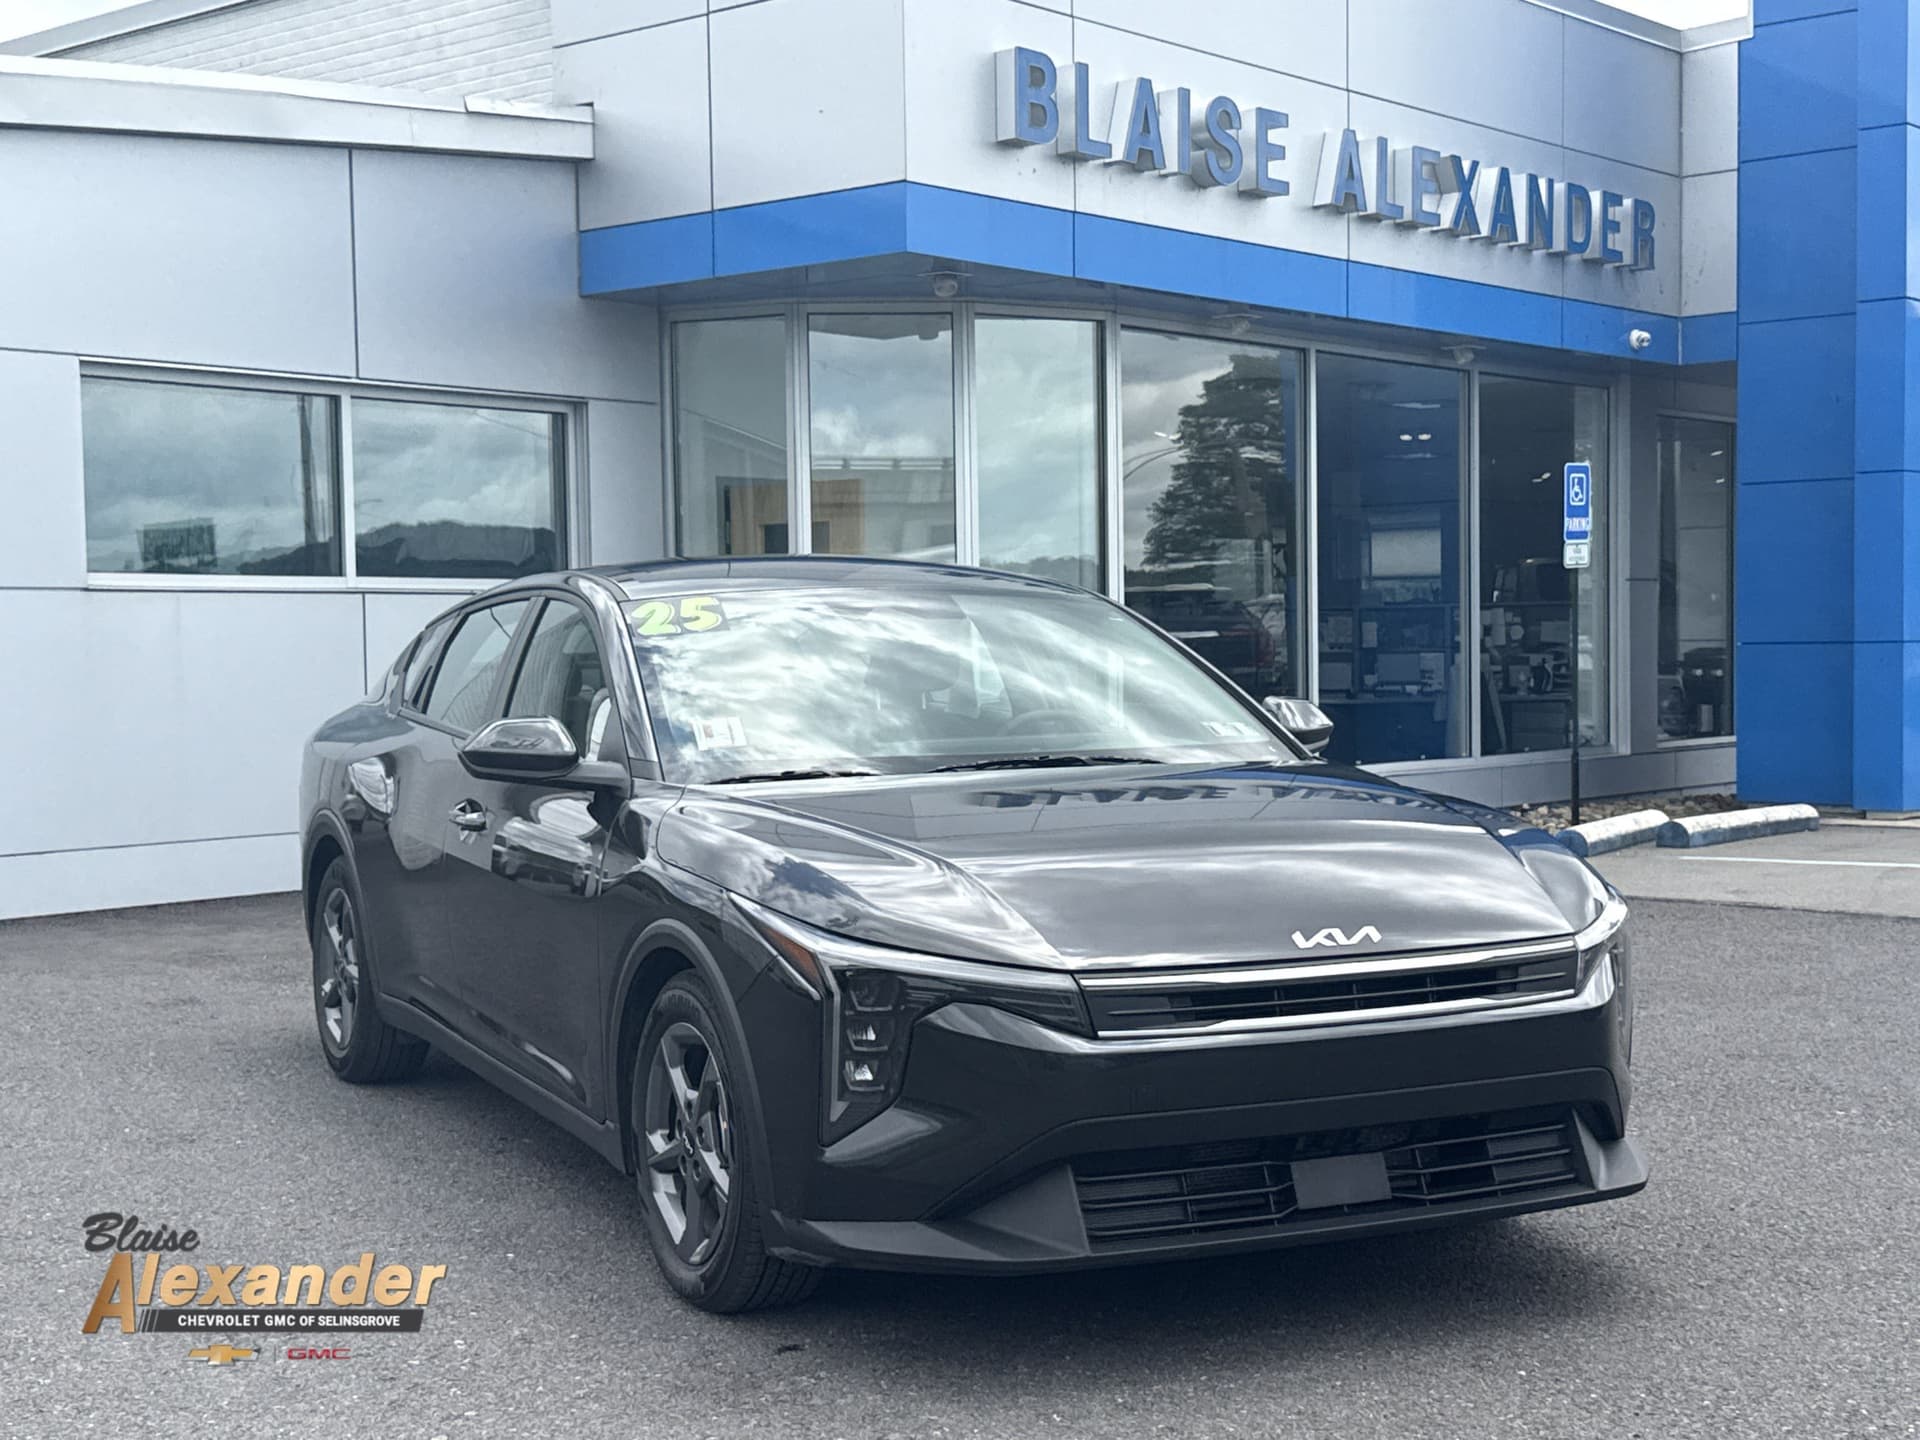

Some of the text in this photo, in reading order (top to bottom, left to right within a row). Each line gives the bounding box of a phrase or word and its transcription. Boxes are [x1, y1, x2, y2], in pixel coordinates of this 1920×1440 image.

[1014, 46, 1656, 272] BLAISE ALEXANDER
[631, 596, 722, 636] 25
